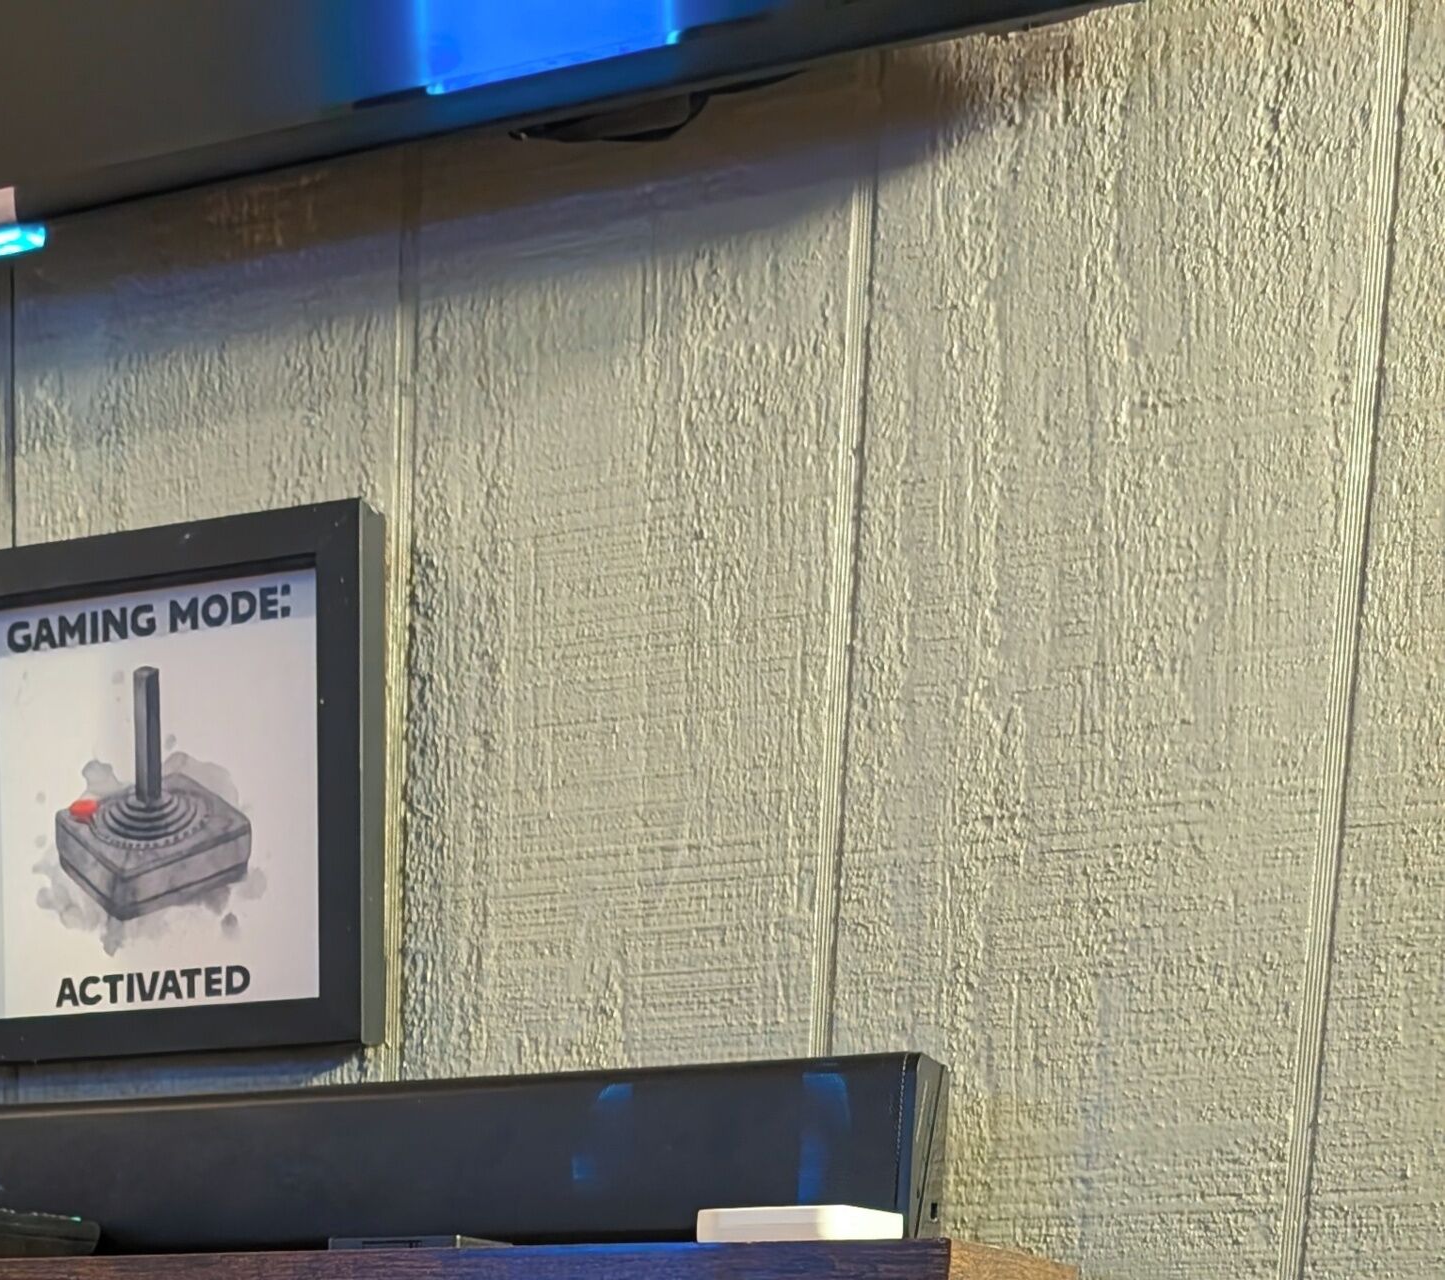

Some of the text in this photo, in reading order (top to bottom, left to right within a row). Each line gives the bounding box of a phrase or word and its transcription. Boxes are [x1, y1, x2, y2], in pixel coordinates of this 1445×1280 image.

[6, 583, 294, 655] GAMING MODE:
[54, 964, 252, 1008] ACTIVATED
